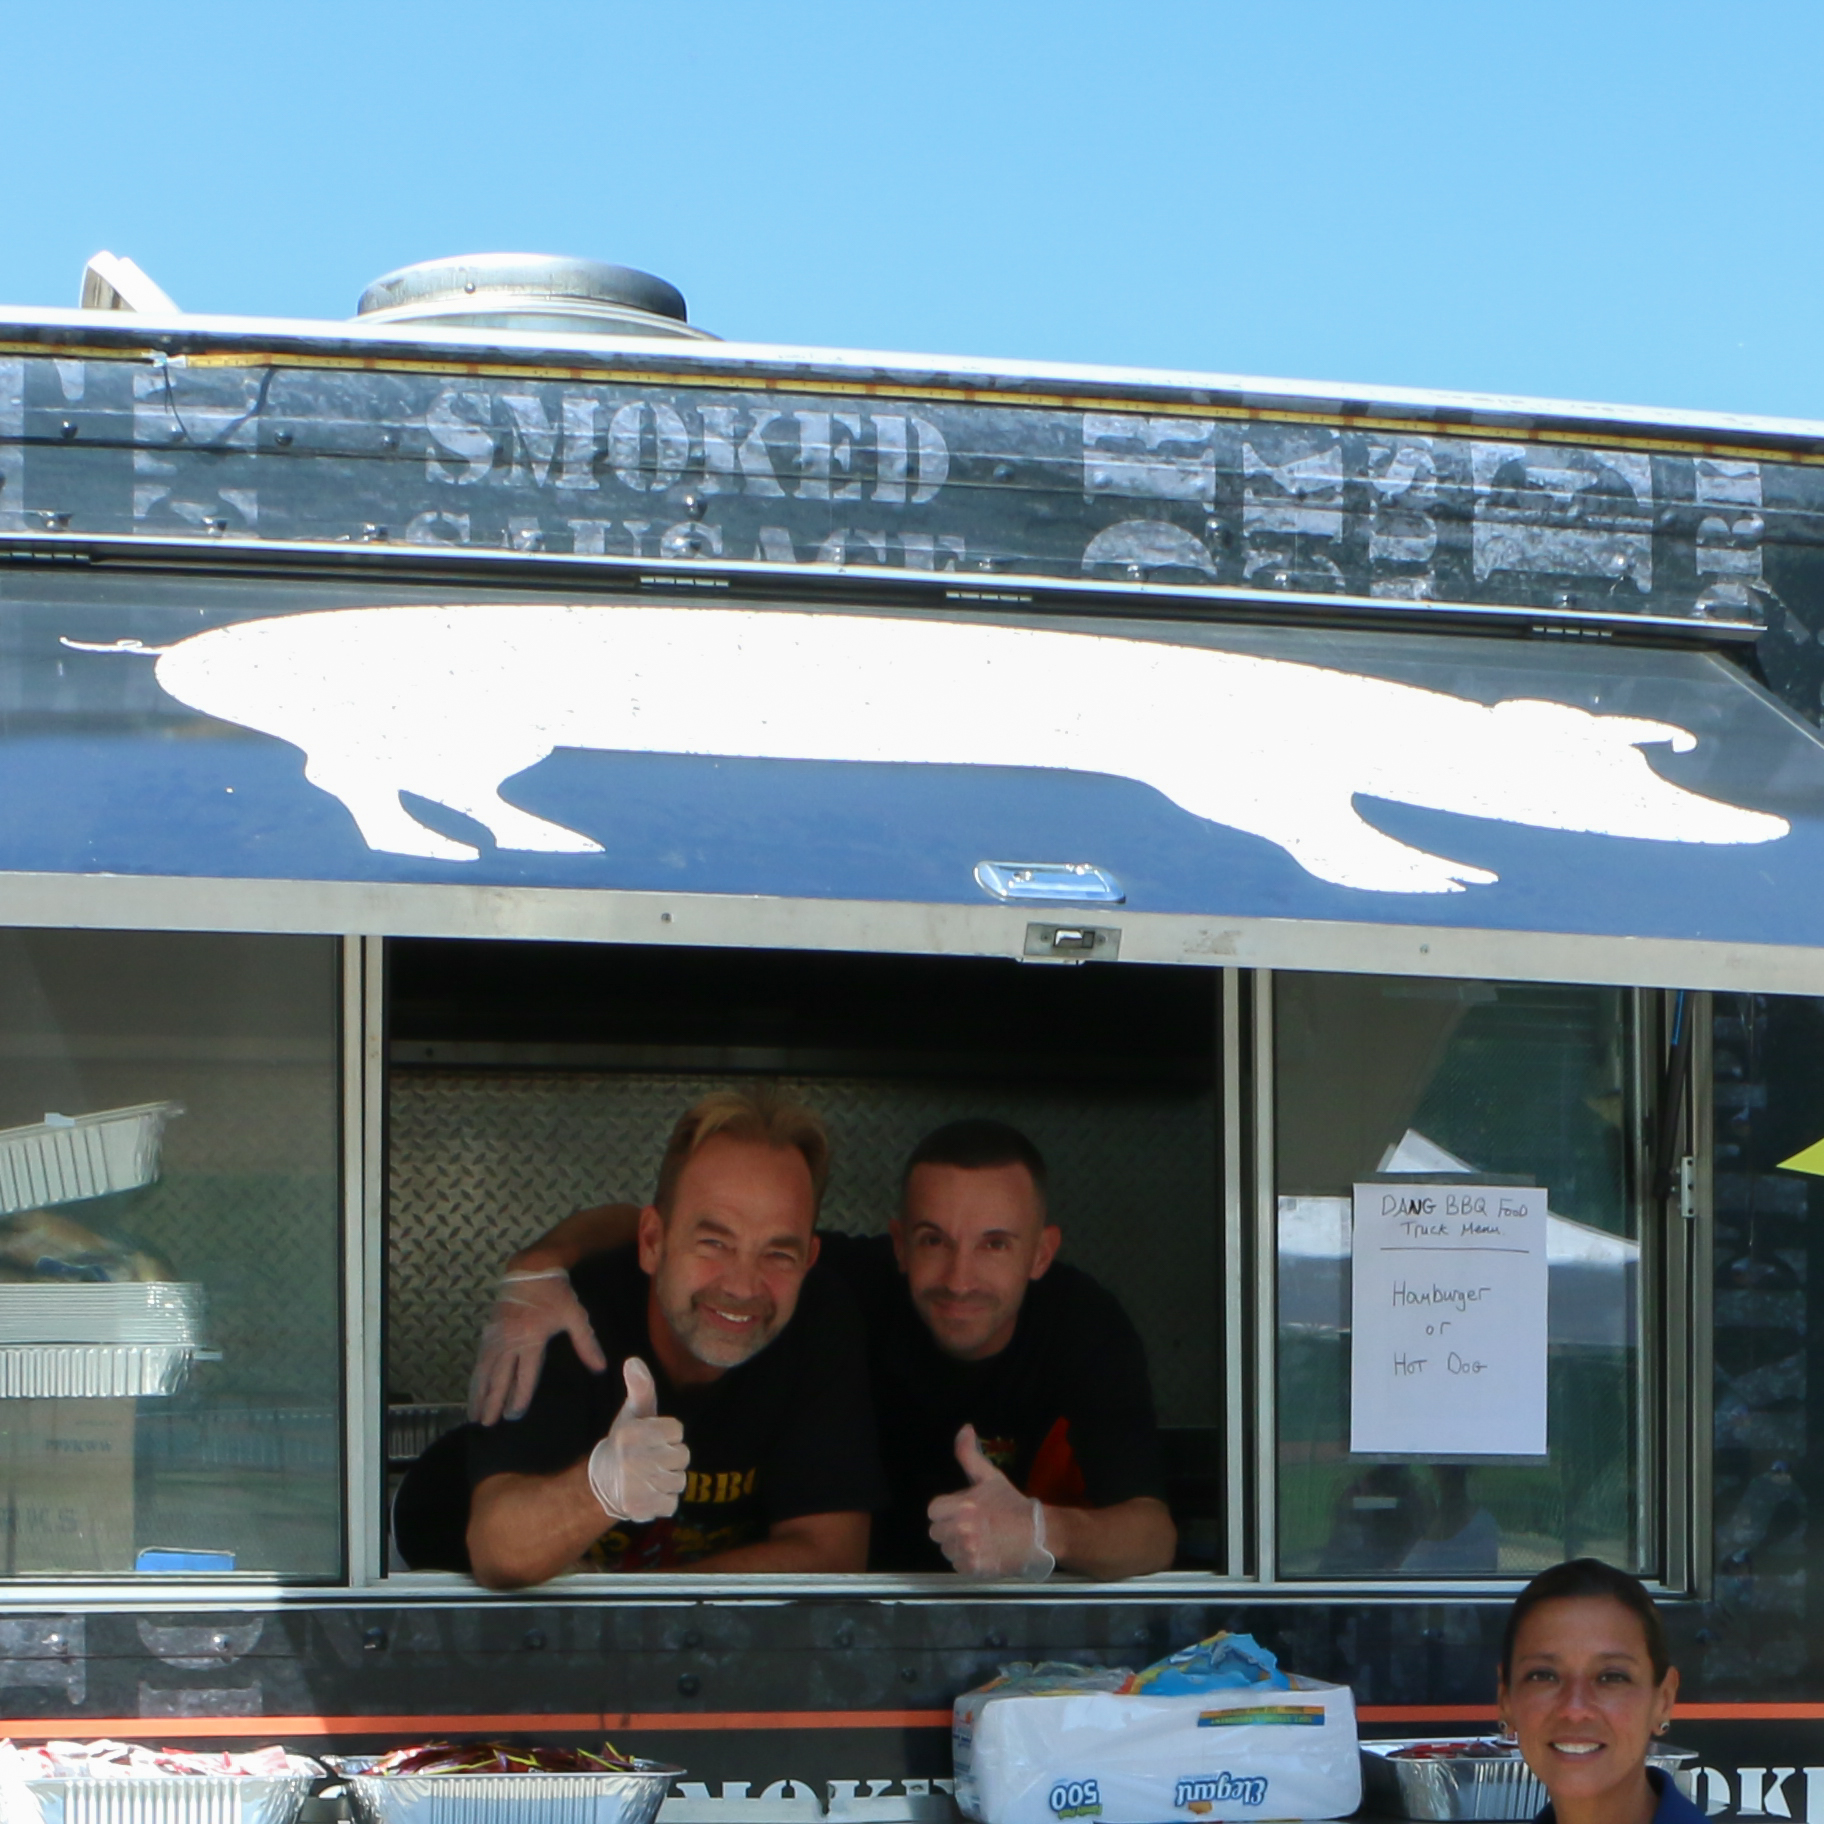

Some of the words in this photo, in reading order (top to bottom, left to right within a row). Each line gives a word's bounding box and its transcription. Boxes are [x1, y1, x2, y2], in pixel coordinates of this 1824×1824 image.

[422, 387, 951, 506] SMOKED
[1381, 1194, 1437, 1217] DANG
[1445, 1195, 1487, 1217] BBQ
[1392, 1280, 1492, 1312] Hamburger
[1425, 1322, 1452, 1336] or
[1050, 1780, 1099, 1810] 500
[1174, 1771, 1267, 1809] Elegant
